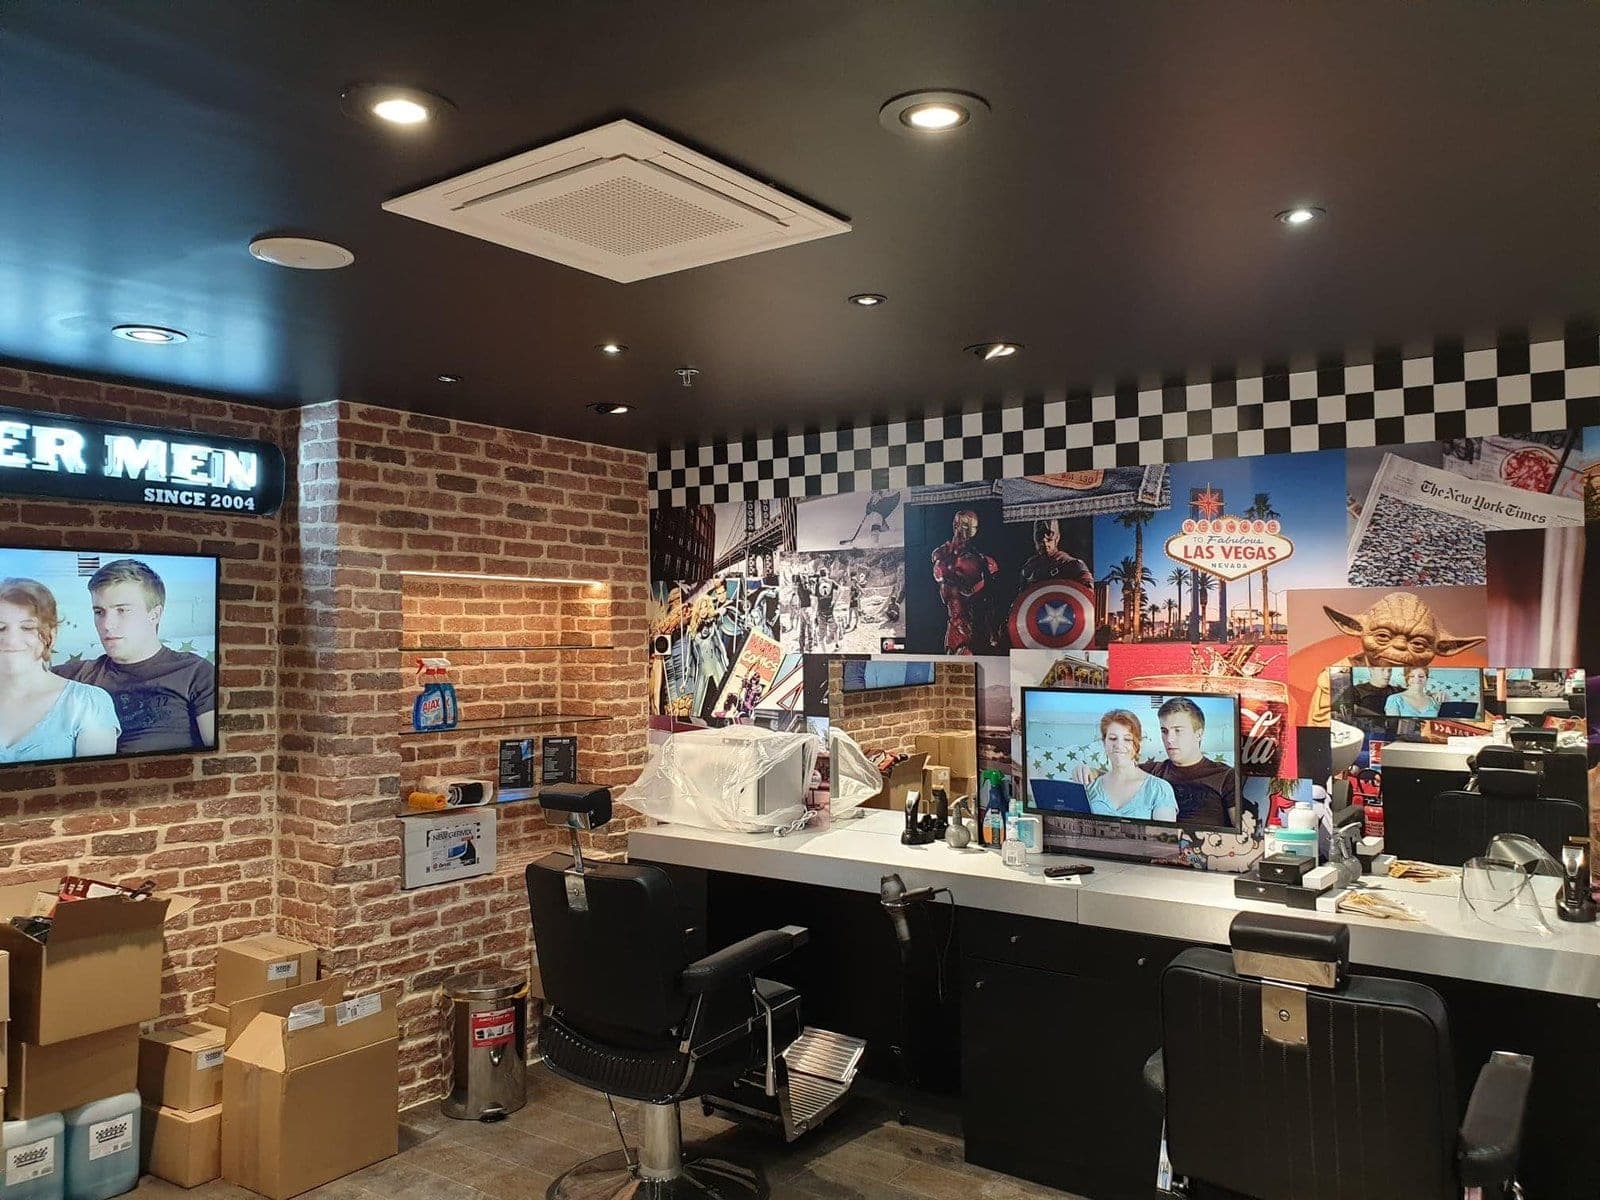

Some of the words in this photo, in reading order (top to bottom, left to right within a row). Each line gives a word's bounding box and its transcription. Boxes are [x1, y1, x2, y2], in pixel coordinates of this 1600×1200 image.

[103, 434, 257, 491] MEN
[144, 488, 206, 507] SINCE
[210, 494, 255, 511] 2004
[1420, 480, 1444, 497] The
[1443, 487, 1473, 505] New
[1472, 495, 1504, 514] York
[1505, 503, 1547, 524] Times
[1182, 519, 1280, 534] WELCOME
[1206, 535, 1264, 545] Fabulous
[1183, 545, 1215, 559] LAS
[1220, 545, 1277, 560] VEGAS
[422, 698, 440, 711] AJAX
